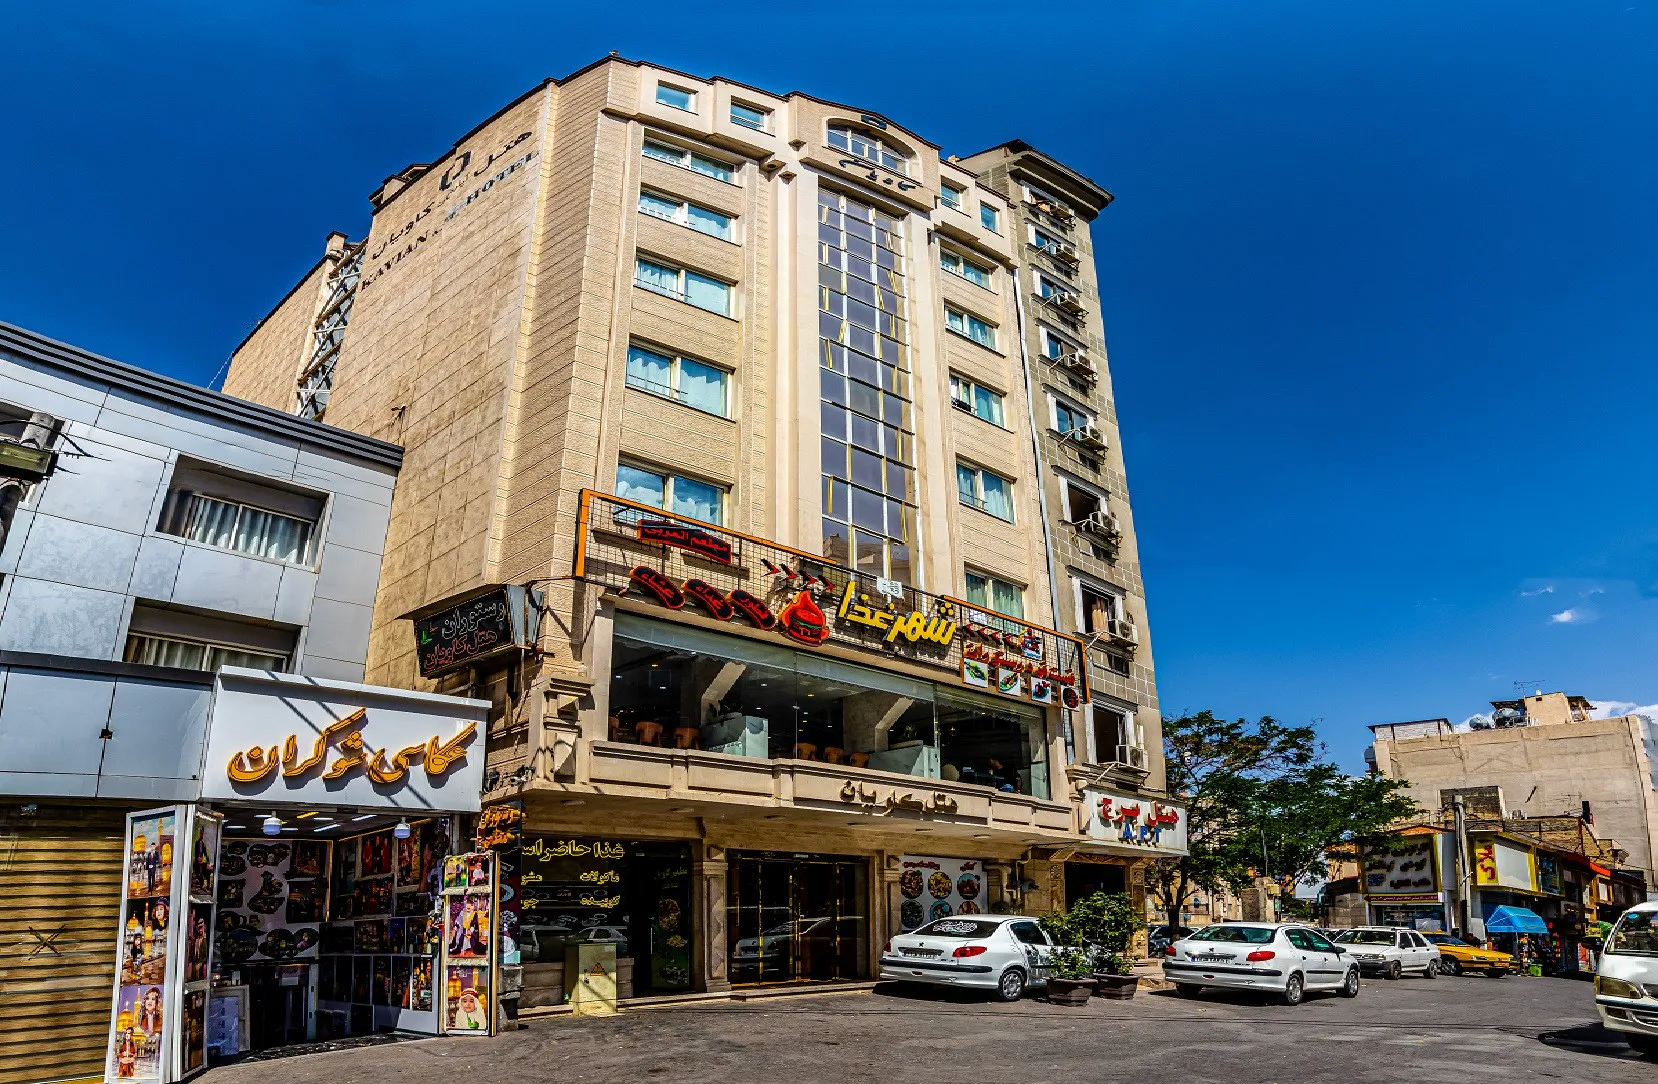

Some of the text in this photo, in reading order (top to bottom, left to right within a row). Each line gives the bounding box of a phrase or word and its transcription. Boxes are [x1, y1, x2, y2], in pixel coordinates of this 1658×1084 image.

[474, 132, 533, 177] هتل
[361, 231, 429, 290] KAVIAN
[466, 150, 539, 206] HOTEL
[373, 202, 434, 260] کاویان
[442, 602, 506, 639] رستوران
[838, 580, 895, 630] غذا
[886, 602, 957, 646] شهر
[424, 629, 498, 669] هتل کاویان
[227, 707, 478, 783] عکاسی شوکران
[839, 780, 958, 816] هتل کاویان
[1144, 800, 1179, 827] هتل
[539, 840, 592, 861] حاضر
[594, 840, 625, 860] غذا
